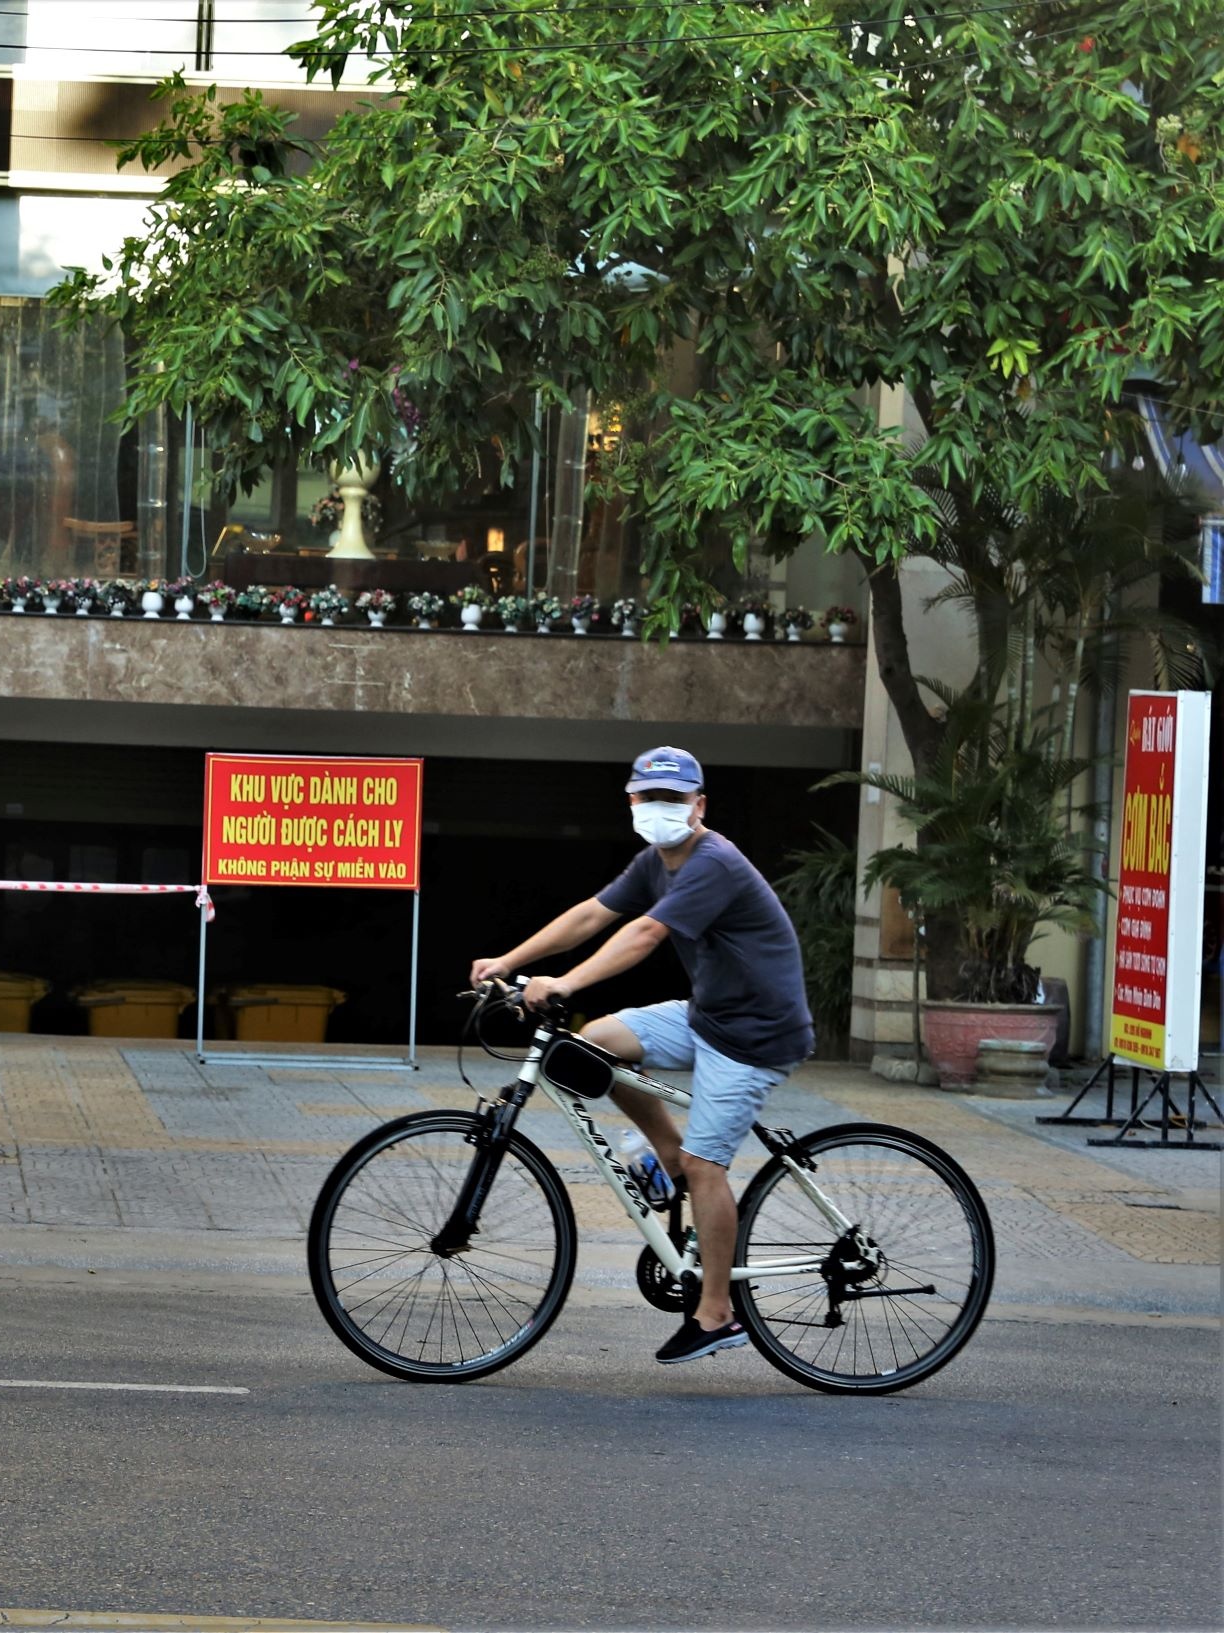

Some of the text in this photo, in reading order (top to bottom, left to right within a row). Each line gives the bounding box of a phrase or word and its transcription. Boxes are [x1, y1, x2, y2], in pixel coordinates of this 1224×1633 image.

[230, 770, 398, 810] KHU VỰC DÀNH CHO
[222, 810, 404, 853] NGƯỜI ĐƯỢC CÁCH LY
[1123, 762, 1171, 875] CƠM BẮC
[218, 856, 406, 881] KHÔNG PHẬN SỰ MIỄN VÀO
